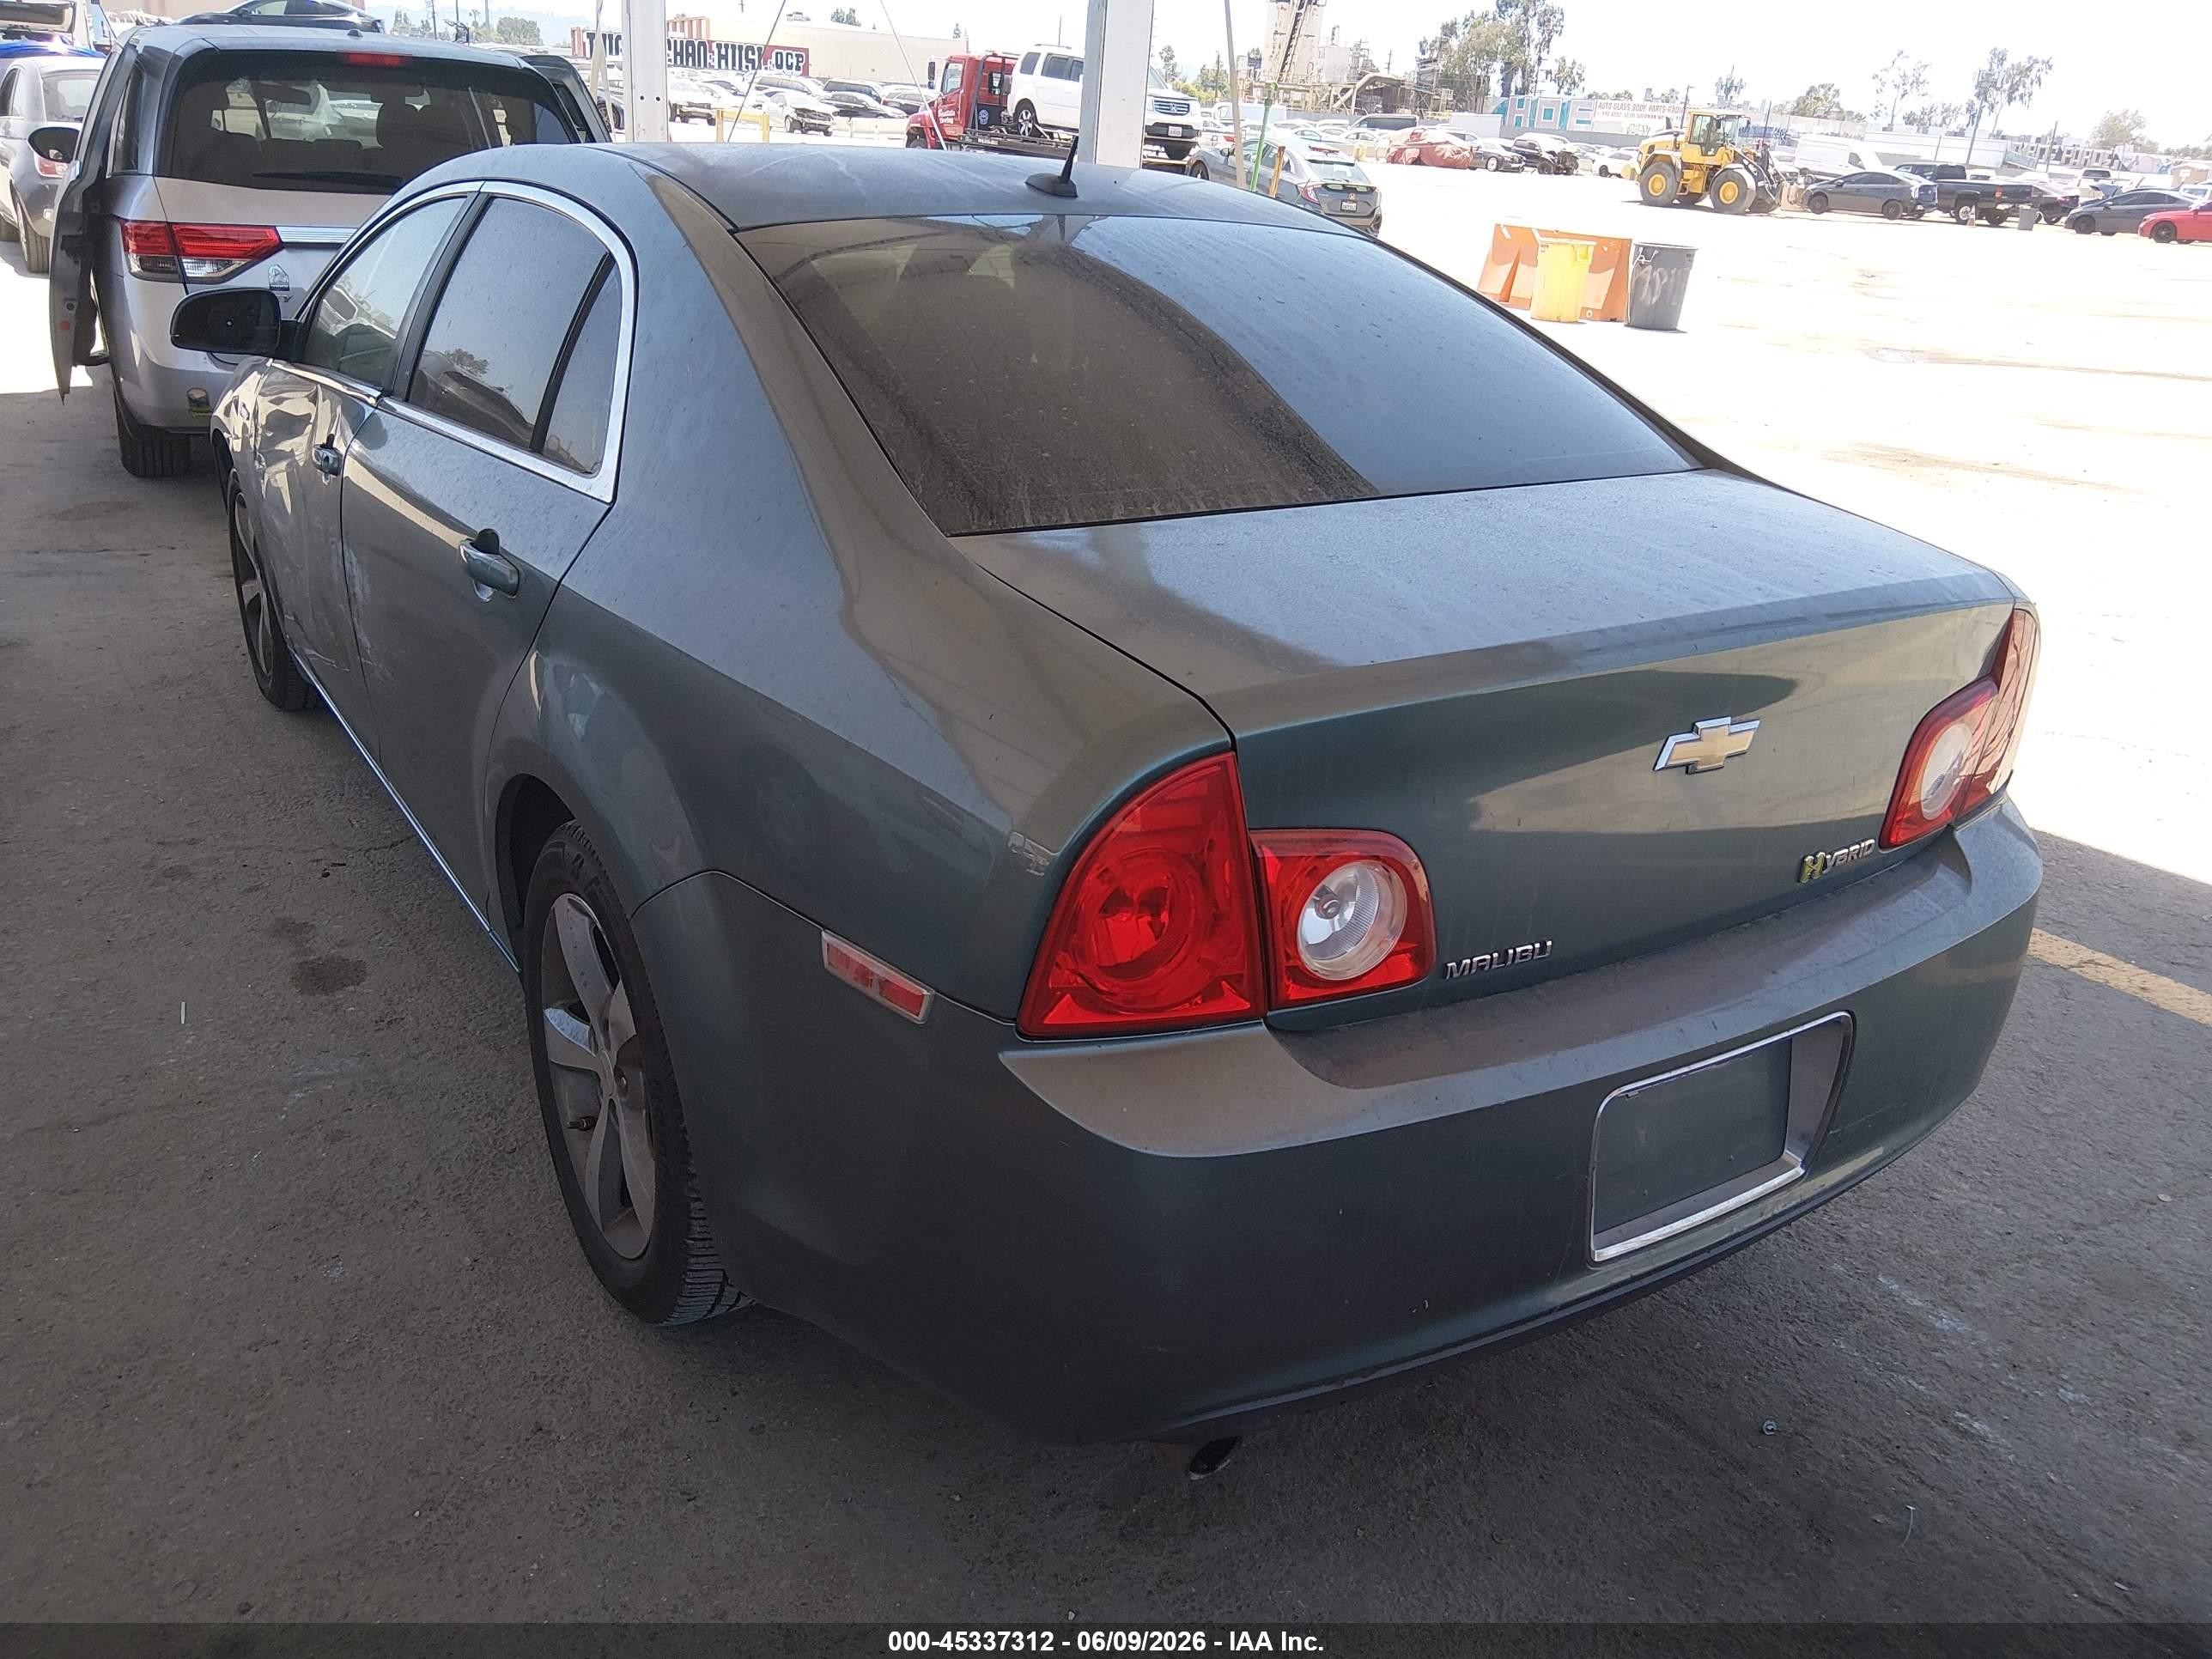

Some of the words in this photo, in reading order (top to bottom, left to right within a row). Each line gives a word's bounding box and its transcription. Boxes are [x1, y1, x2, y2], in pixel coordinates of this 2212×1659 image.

[1613, 102, 1631, 111] GLASS
[1632, 103, 1647, 112] BODY
[1799, 838, 1876, 884] HYBRID
[1445, 940, 1553, 980] MALIBU
